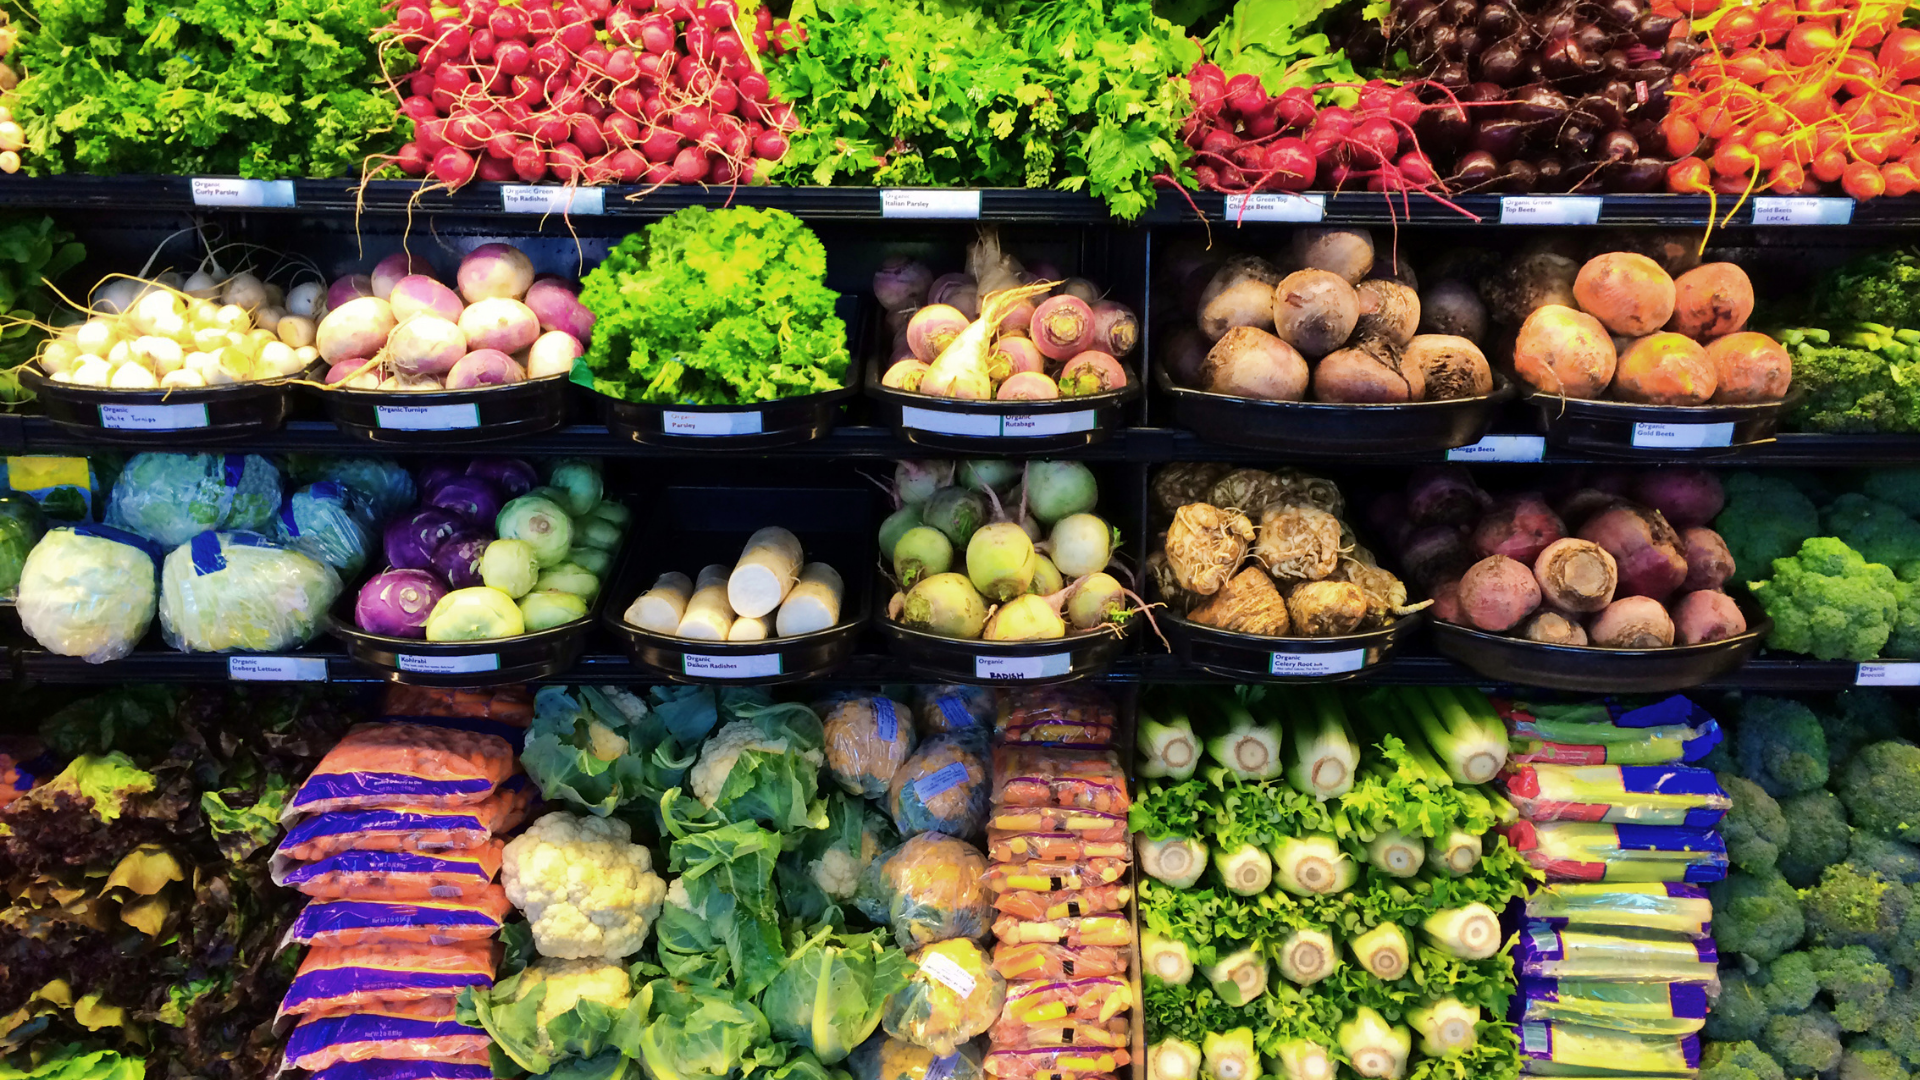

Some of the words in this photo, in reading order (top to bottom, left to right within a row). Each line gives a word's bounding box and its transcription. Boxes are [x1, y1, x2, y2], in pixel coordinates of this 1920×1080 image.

[194, 181, 220, 189] Organic
[1229, 195, 1254, 203] Orgic
[378, 405, 403, 413] Organic
[1638, 422, 1665, 430] Organic
[400, 656, 427, 664] Kohlrabi
